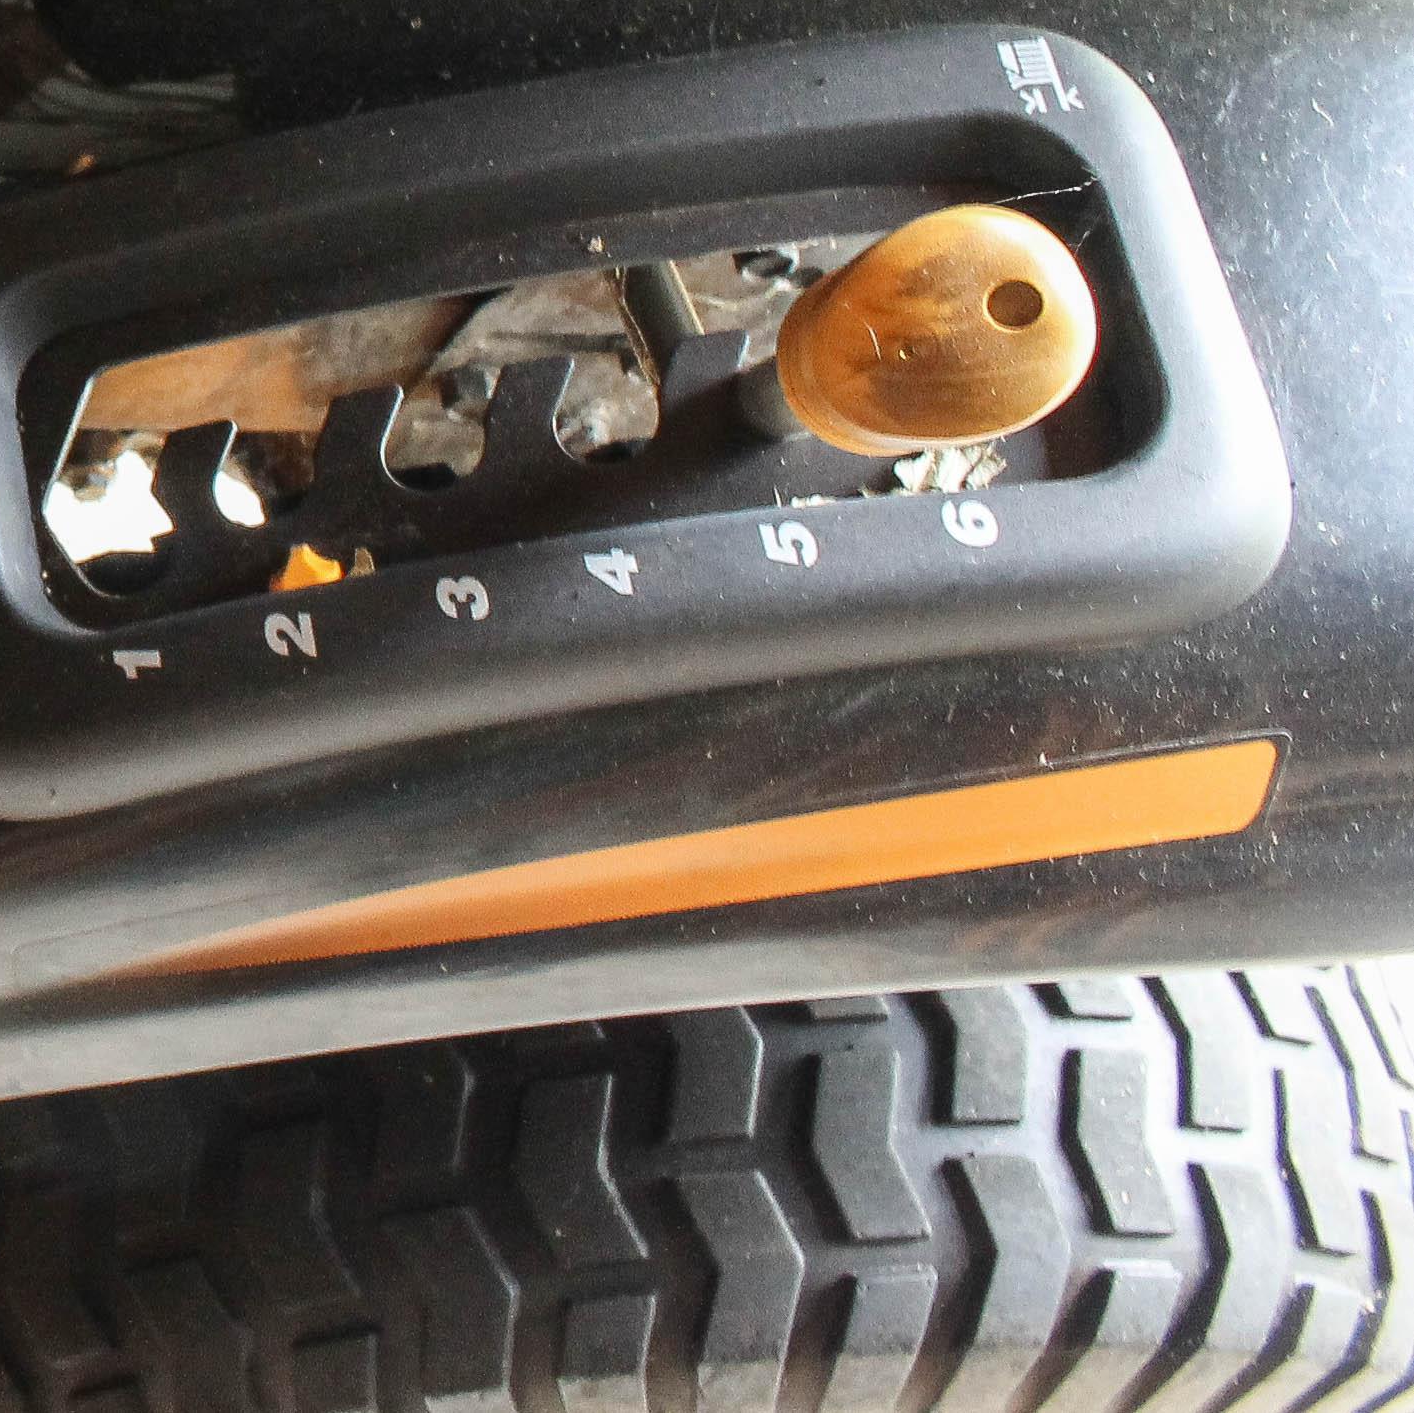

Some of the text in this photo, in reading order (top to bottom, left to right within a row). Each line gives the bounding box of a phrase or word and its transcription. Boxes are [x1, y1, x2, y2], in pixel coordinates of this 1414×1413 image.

[758, 519, 819, 567] 5
[941, 499, 999, 548] 6
[583, 547, 640, 595] 4
[435, 575, 490, 620] 3
[264, 611, 318, 657] 2
[112, 649, 162, 679] 1
